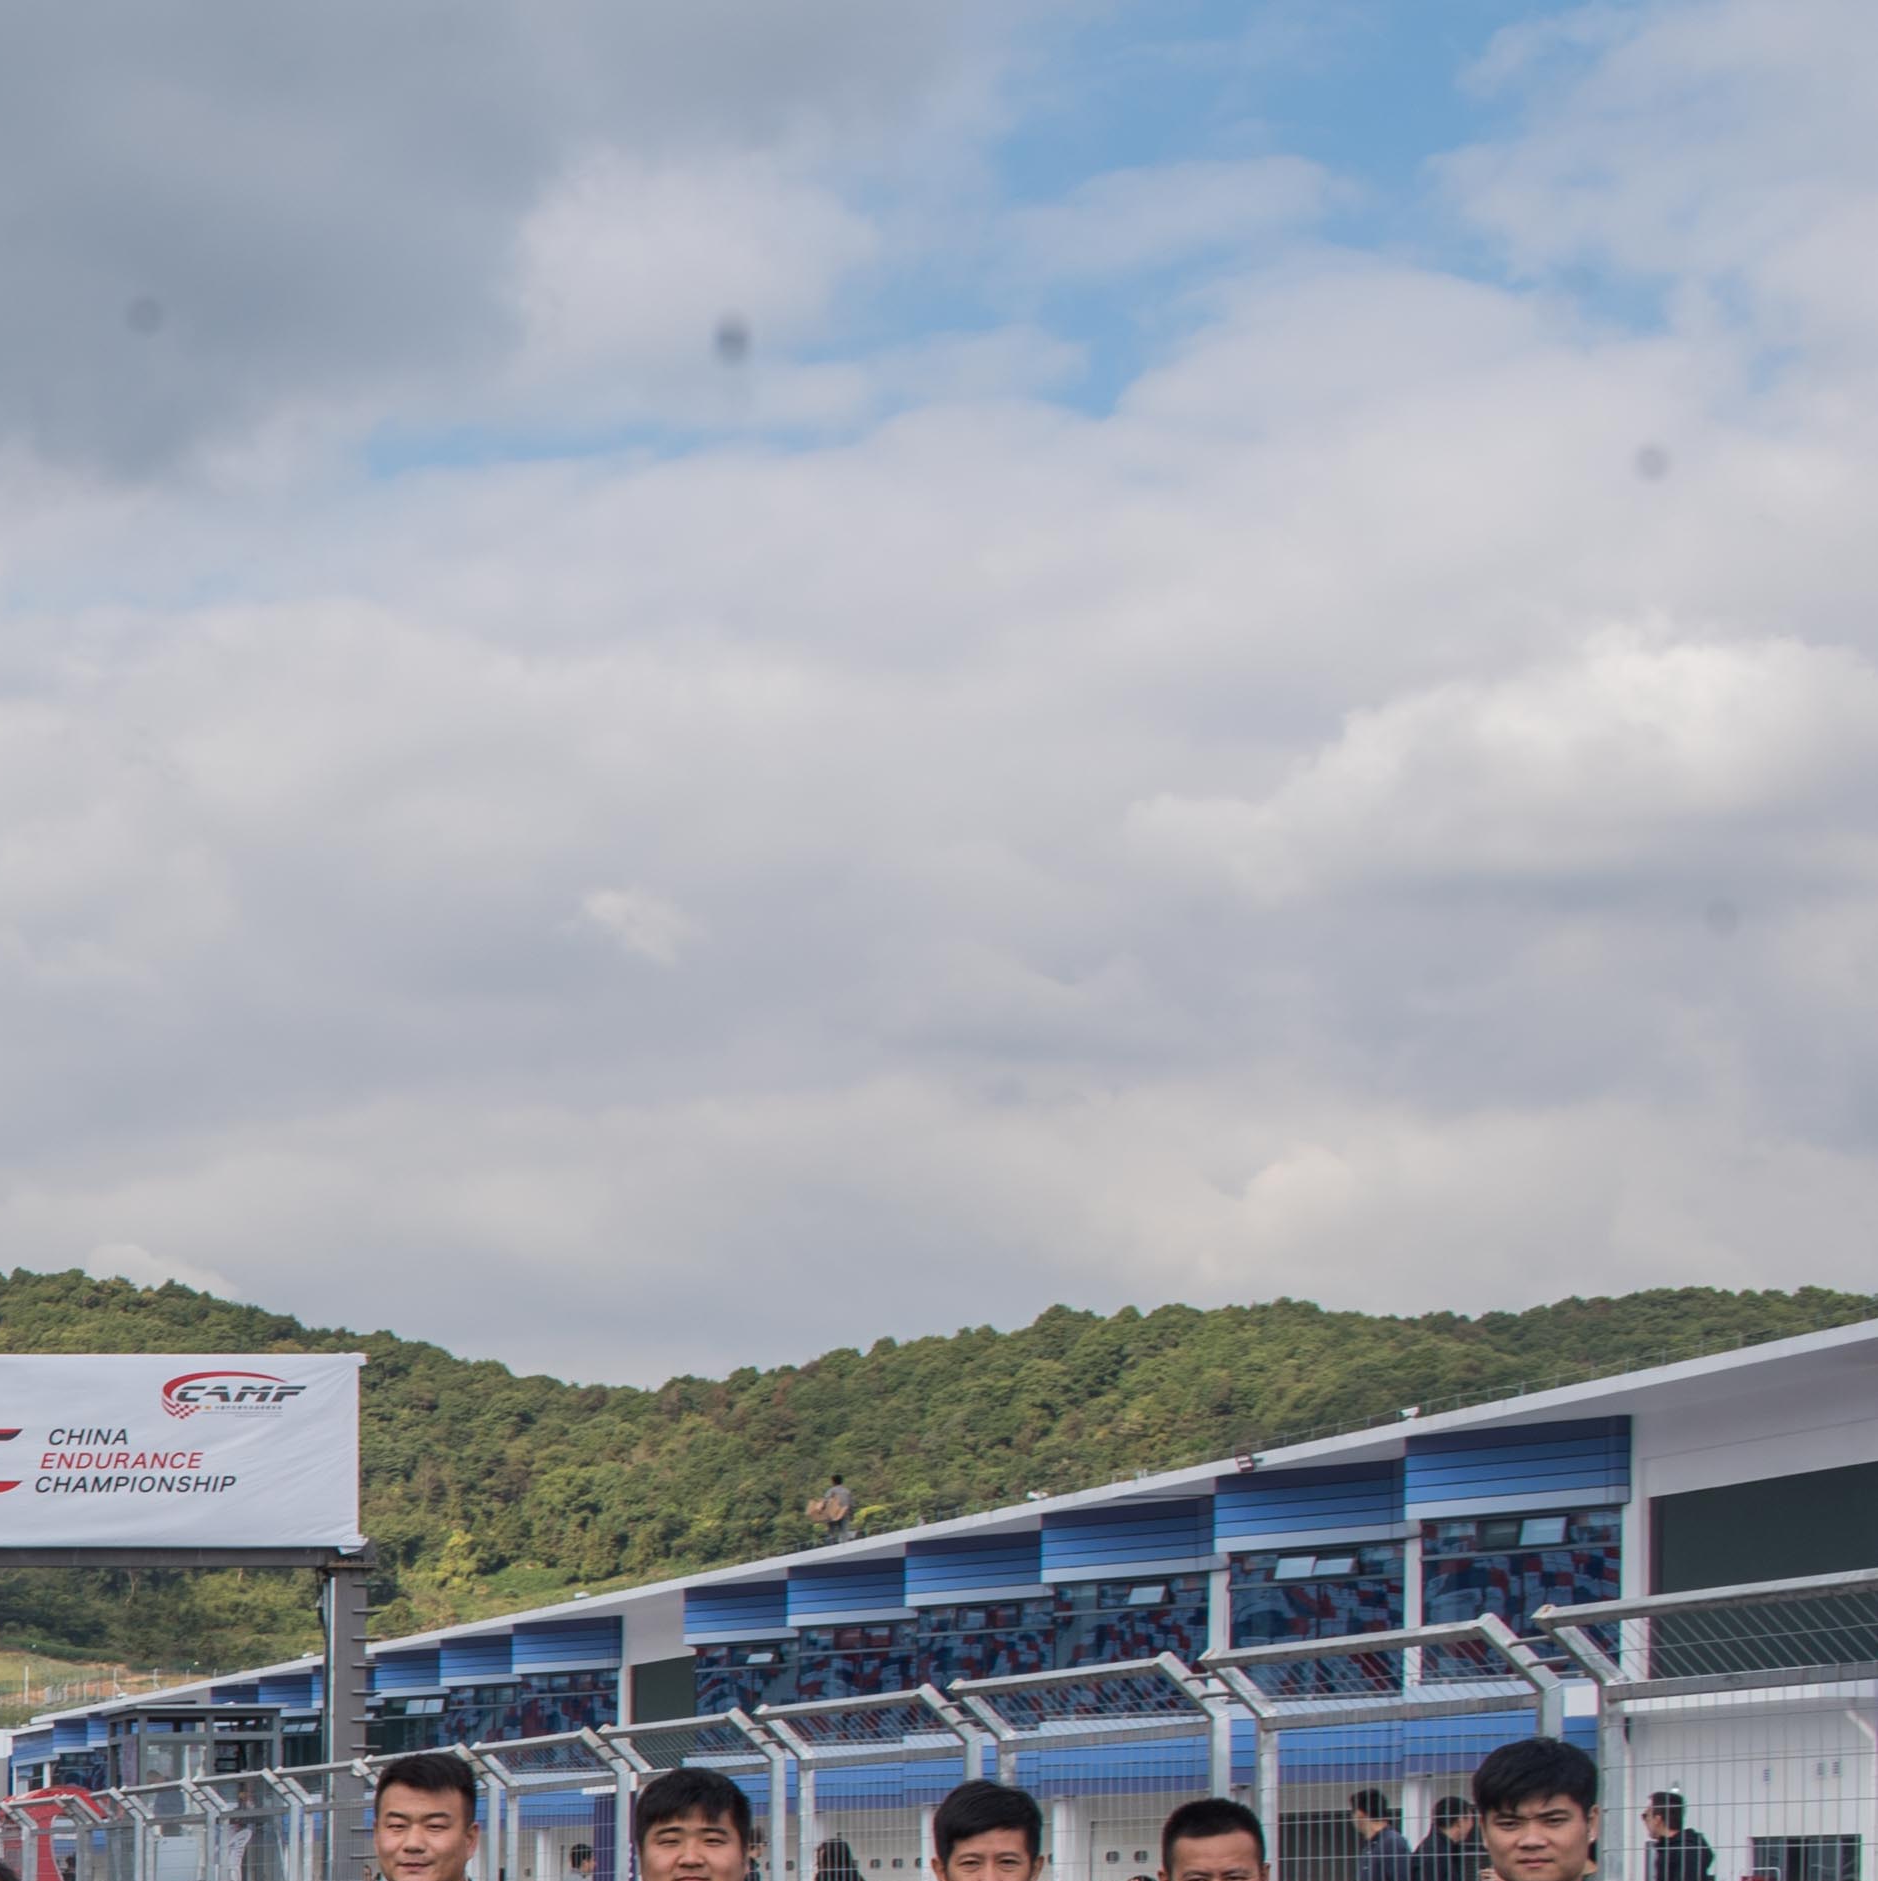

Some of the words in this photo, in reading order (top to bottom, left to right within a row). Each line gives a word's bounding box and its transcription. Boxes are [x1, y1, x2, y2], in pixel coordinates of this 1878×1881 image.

[176, 1385, 307, 1402] CAMF
[48, 1428, 129, 1446] CHINA
[41, 1452, 204, 1470] ENDURANCE
[34, 1475, 237, 1494] CHAMPIONSHIP
